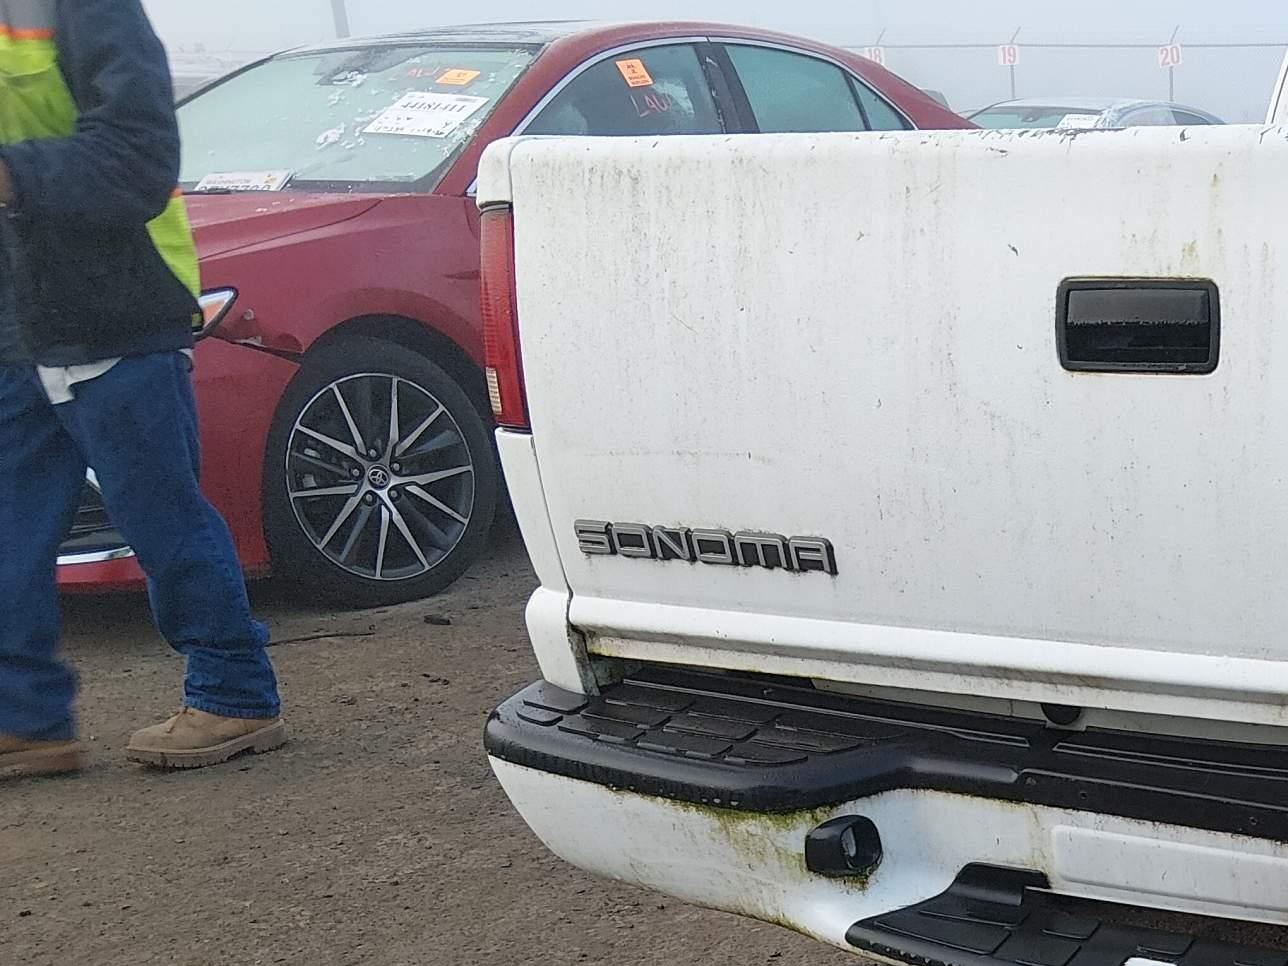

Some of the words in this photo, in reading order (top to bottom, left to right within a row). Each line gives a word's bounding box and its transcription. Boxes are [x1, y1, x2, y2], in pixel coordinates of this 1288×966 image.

[1001, 46, 1017, 64] 19
[1160, 46, 1180, 66] 20
[574, 519, 838, 575] SONOMA
